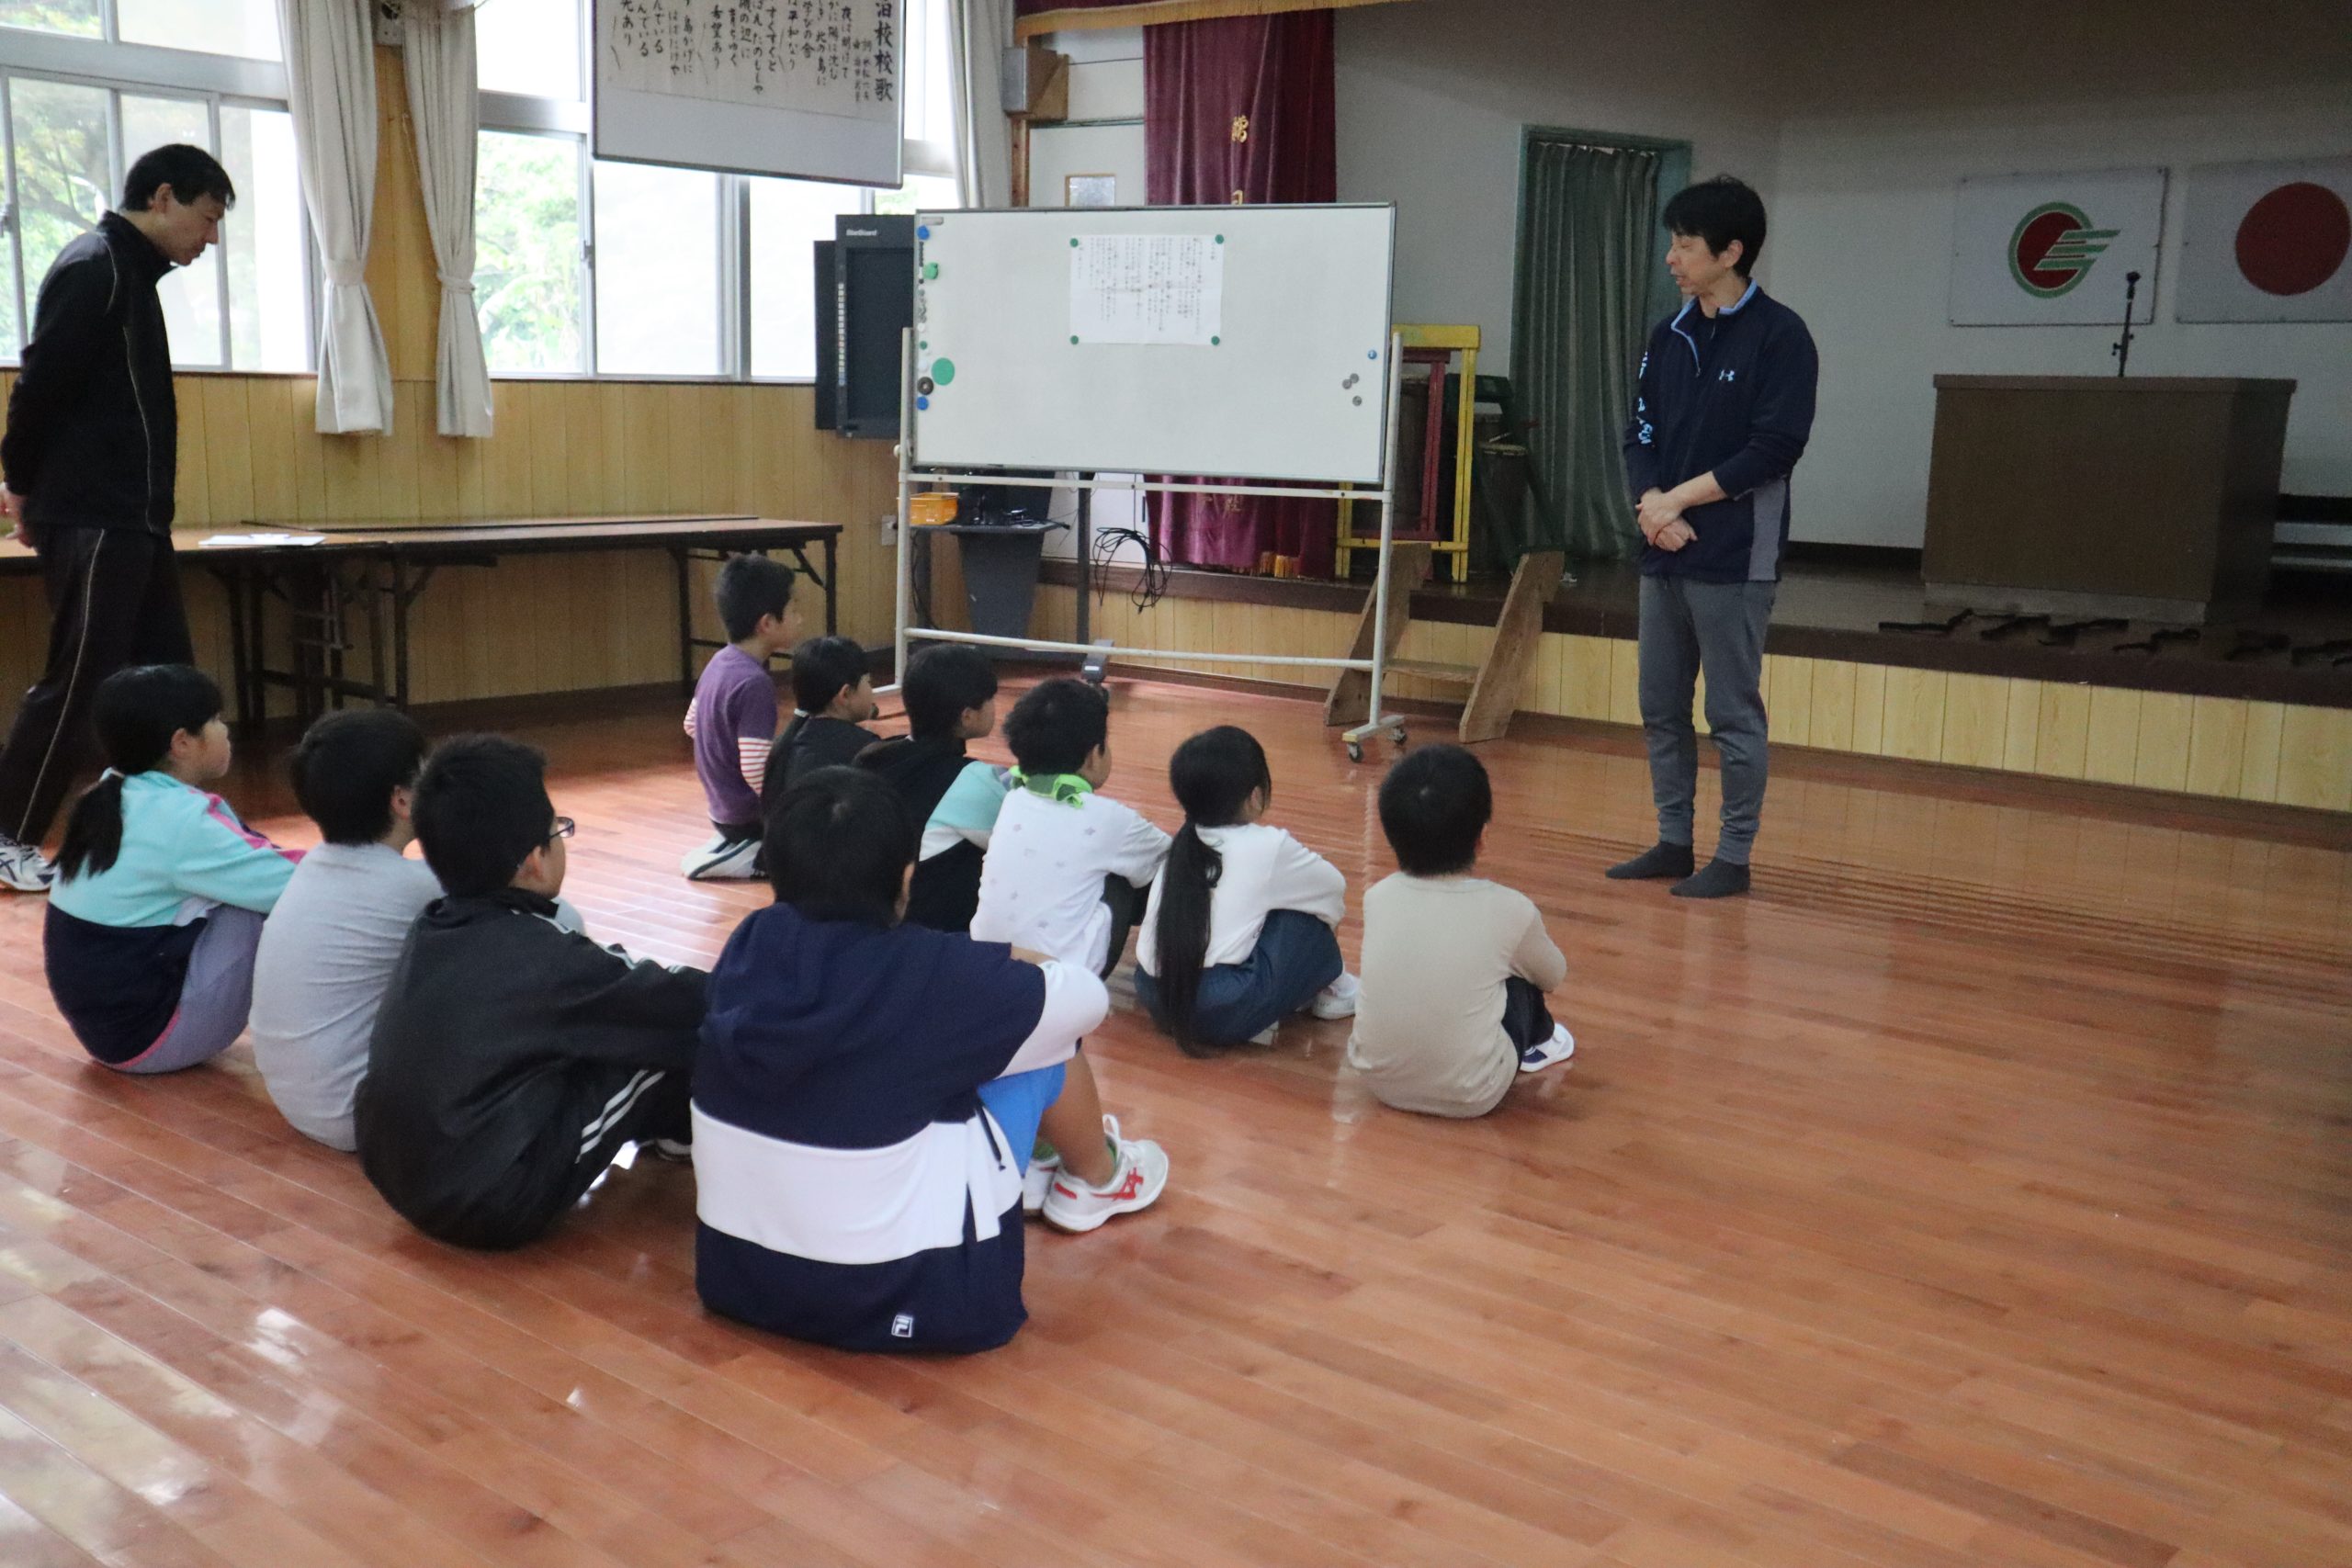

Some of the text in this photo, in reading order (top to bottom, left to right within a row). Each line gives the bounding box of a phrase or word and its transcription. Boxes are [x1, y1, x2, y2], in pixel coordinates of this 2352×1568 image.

[765, 6, 777, 73] すくすくと
